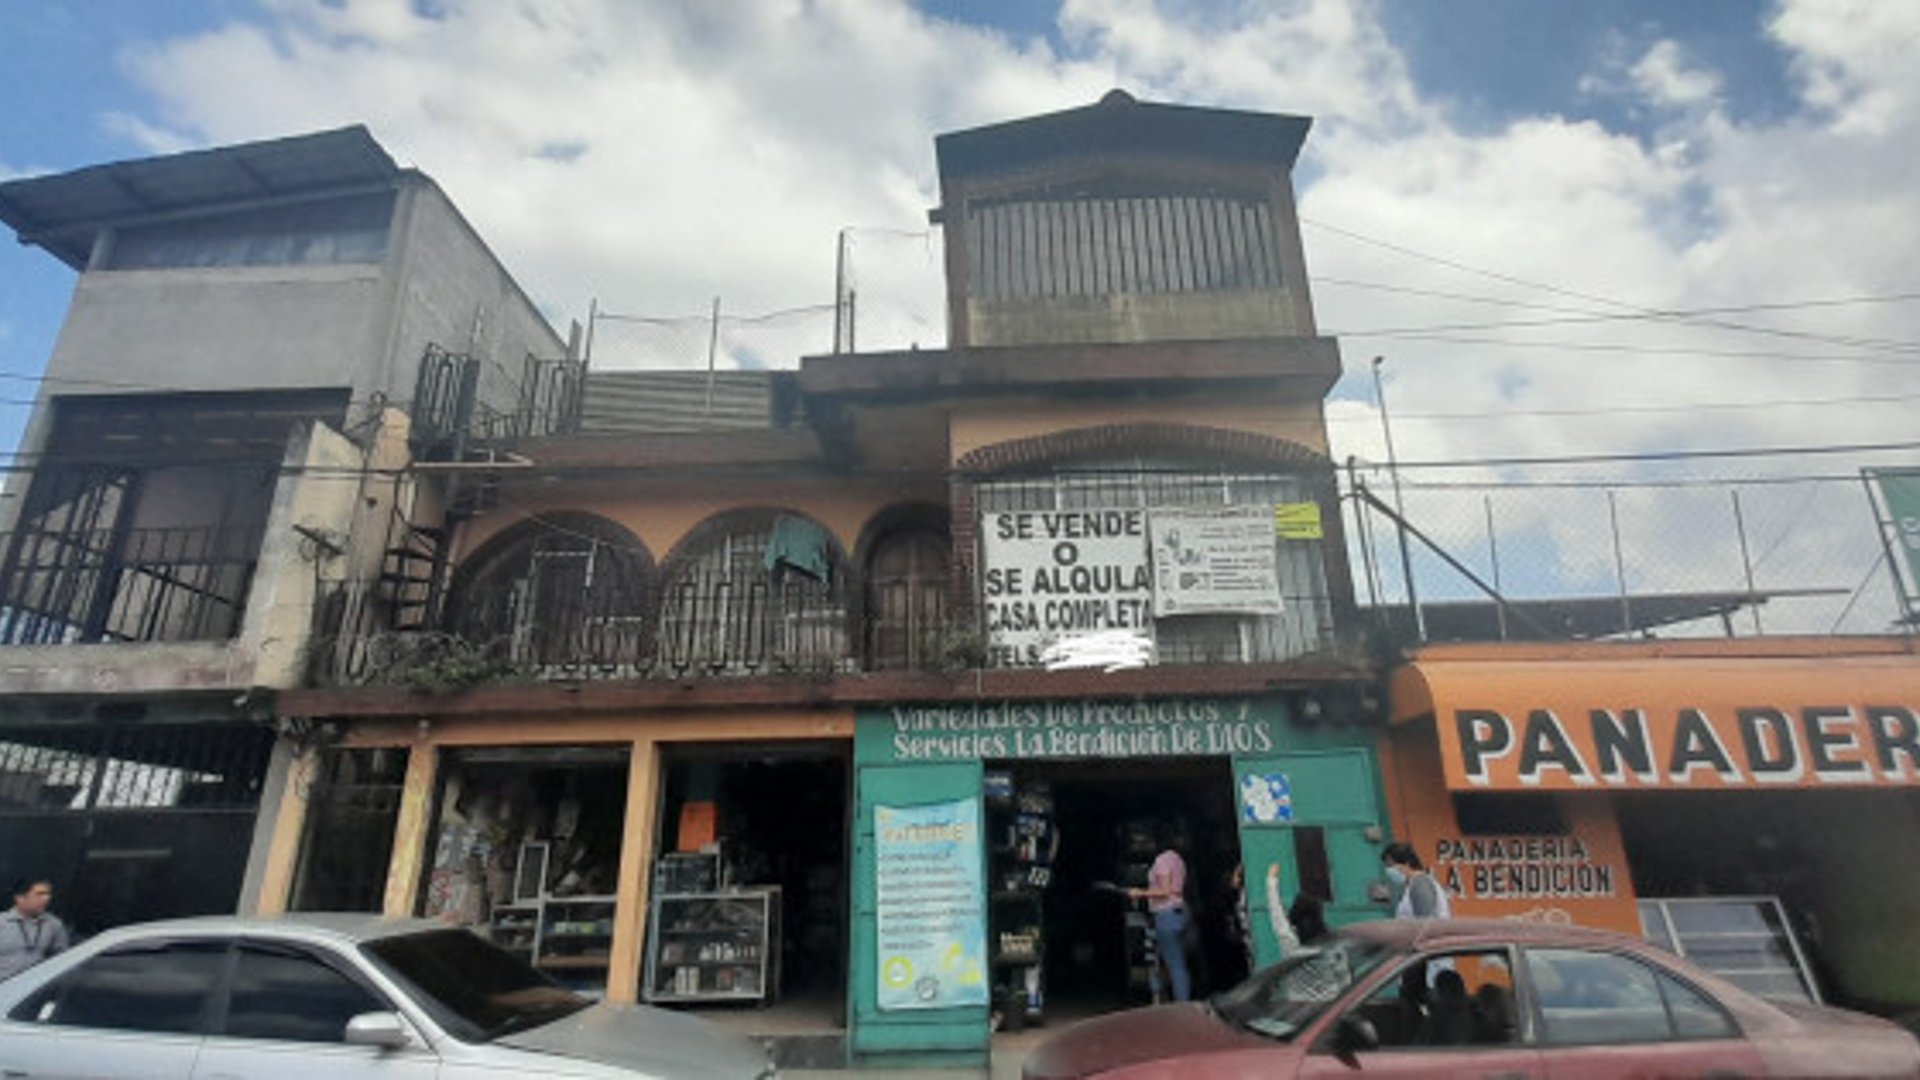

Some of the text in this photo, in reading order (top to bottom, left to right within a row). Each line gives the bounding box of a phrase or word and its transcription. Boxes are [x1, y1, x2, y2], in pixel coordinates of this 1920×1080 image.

[997, 510, 1142, 539] SE VENDE
[1053, 541, 1078, 566] O
[986, 564, 1150, 596] SE ALQULA
[987, 598, 1150, 631] CASA COMPLETA
[894, 732, 1006, 760] Servicios
[1454, 706, 1920, 786] PANADER
